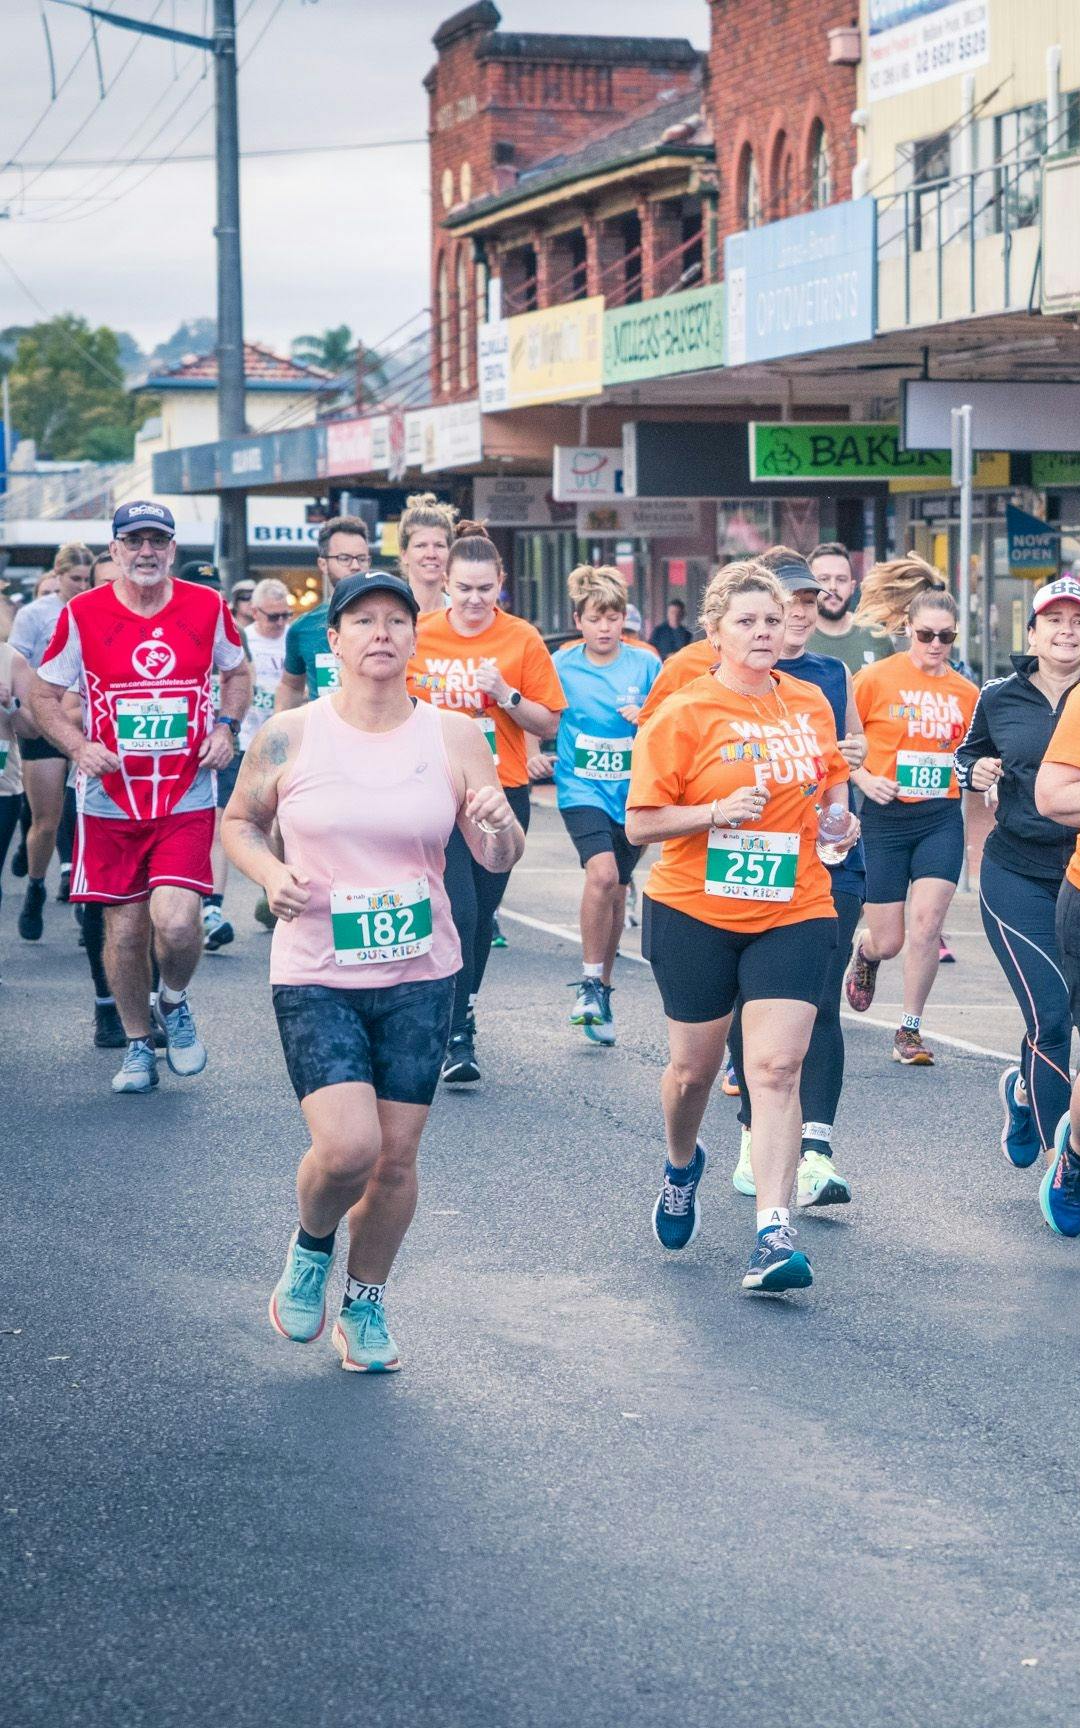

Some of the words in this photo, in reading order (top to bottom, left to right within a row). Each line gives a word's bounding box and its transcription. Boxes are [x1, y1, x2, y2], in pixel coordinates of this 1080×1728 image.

[1013, 535, 1051, 547] NOW
[1011, 549, 1052, 561] OPEN
[898, 690, 960, 707] WALK
[921, 703, 964, 723] RUN
[132, 715, 174, 738] 277
[729, 713, 817, 738] WALK
[766, 734, 824, 760] RUN
[586, 751, 624, 772] 248
[909, 766, 942, 788] 188
[724, 852, 782, 887] 257
[357, 908, 417, 947] 182
[770, 1210, 781, 1222] A
